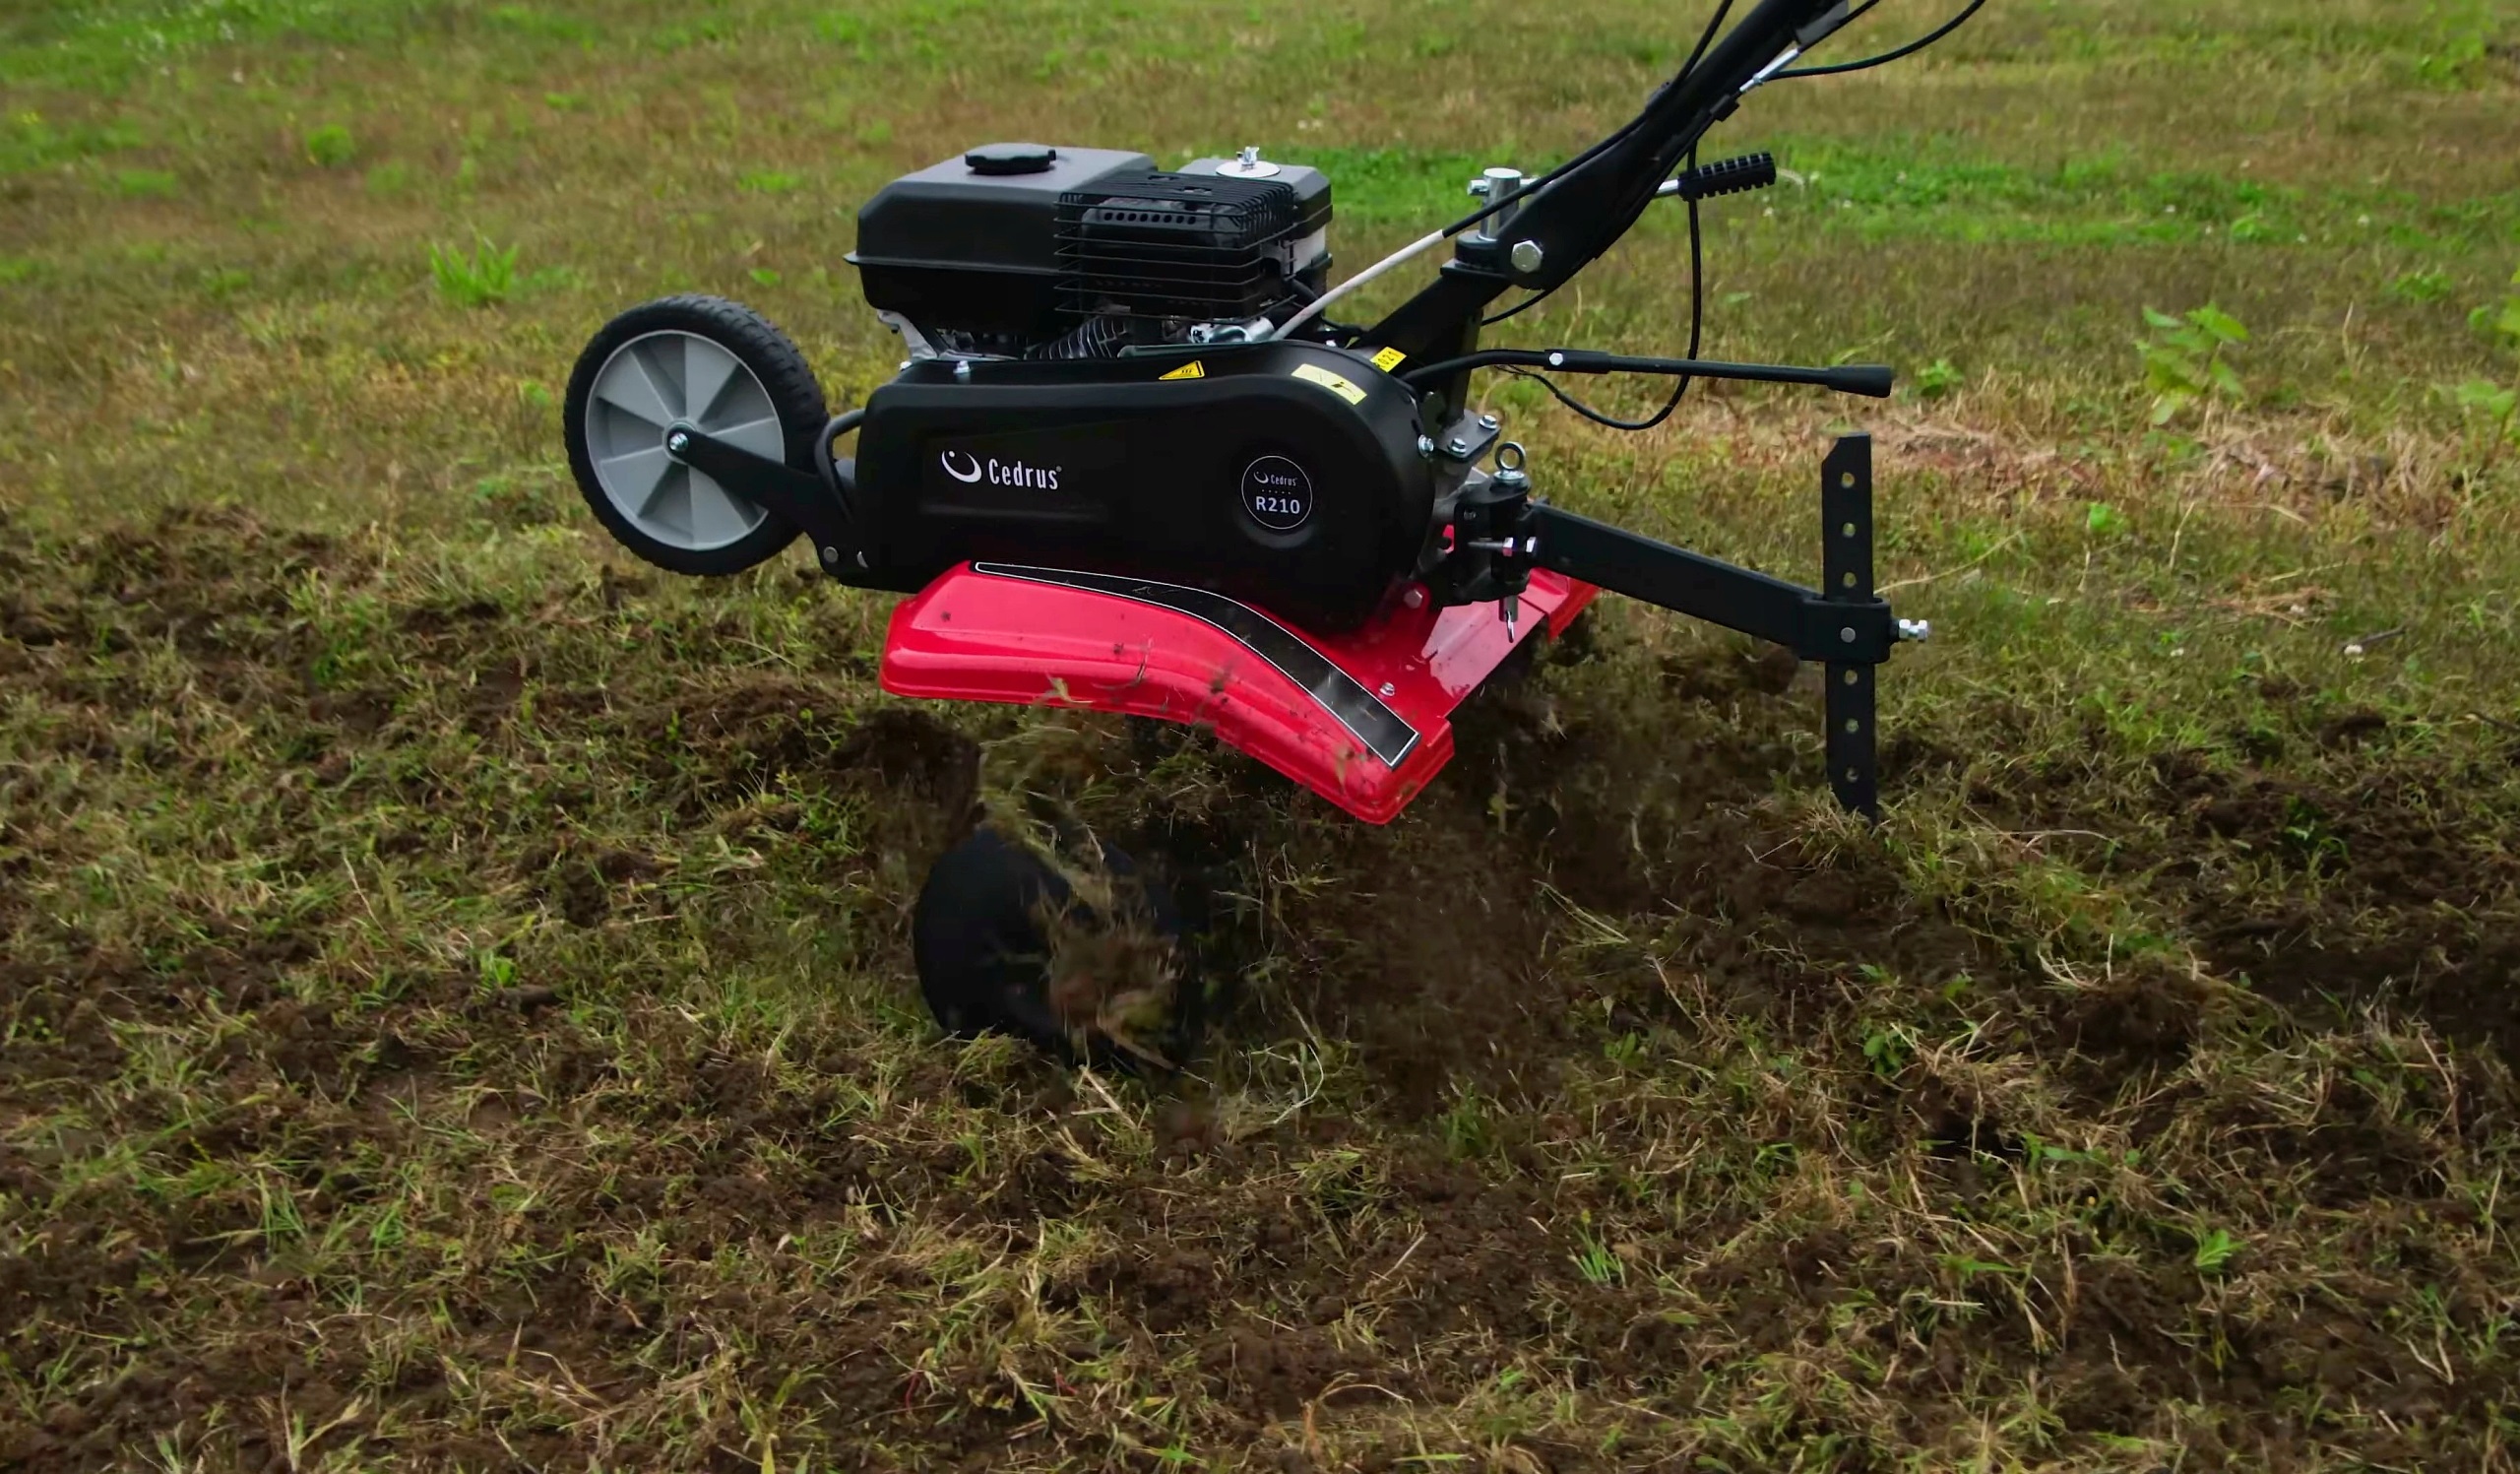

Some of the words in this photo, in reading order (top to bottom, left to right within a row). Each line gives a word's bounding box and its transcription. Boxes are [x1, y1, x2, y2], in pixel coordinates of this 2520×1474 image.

[988, 458, 1058, 490] Cedrus
[1270, 474, 1296, 486] Cedrus
[1255, 495, 1300, 514] R210
